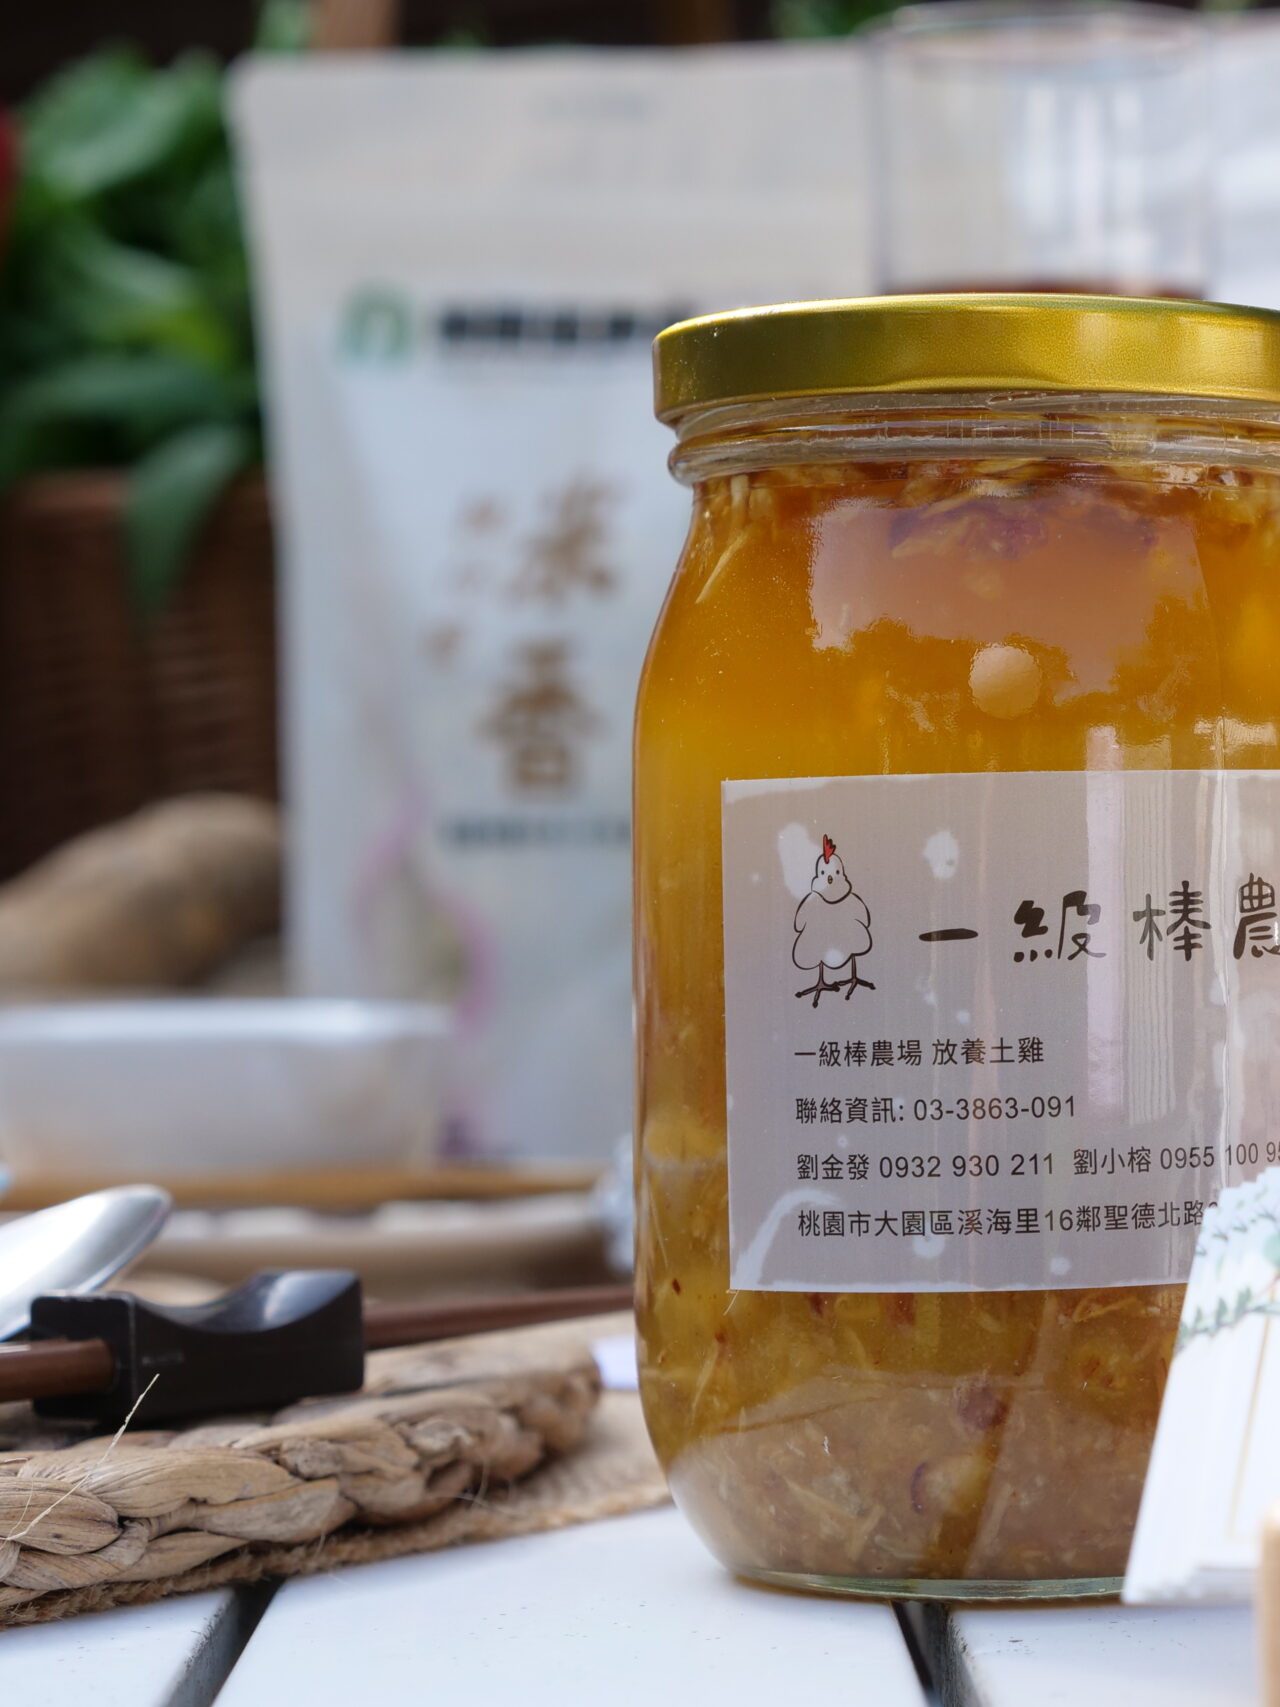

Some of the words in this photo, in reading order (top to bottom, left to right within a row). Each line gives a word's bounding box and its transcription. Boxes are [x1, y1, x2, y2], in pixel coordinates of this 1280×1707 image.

[794, 1039, 923, 1067] 一級棒農場
[932, 1036, 1045, 1066] 放養土雞
[795, 1097, 905, 1124] 聯絡資訊:
[913, 1095, 1075, 1121] 03-3863-091
[797, 1153, 870, 1181] 劉金發
[879, 1155, 941, 1178] 0932
[952, 1154, 1000, 1177] 930
[1010, 1152, 1053, 1176] 211
[1073, 1145, 1152, 1175] 劉小榕
[1160, 1146, 1215, 1170] 0955
[1225, 1142, 1258, 1166] 100
[798, 1200, 1218, 1238] 桃園市大園區溪海里16鄰聖德北路
